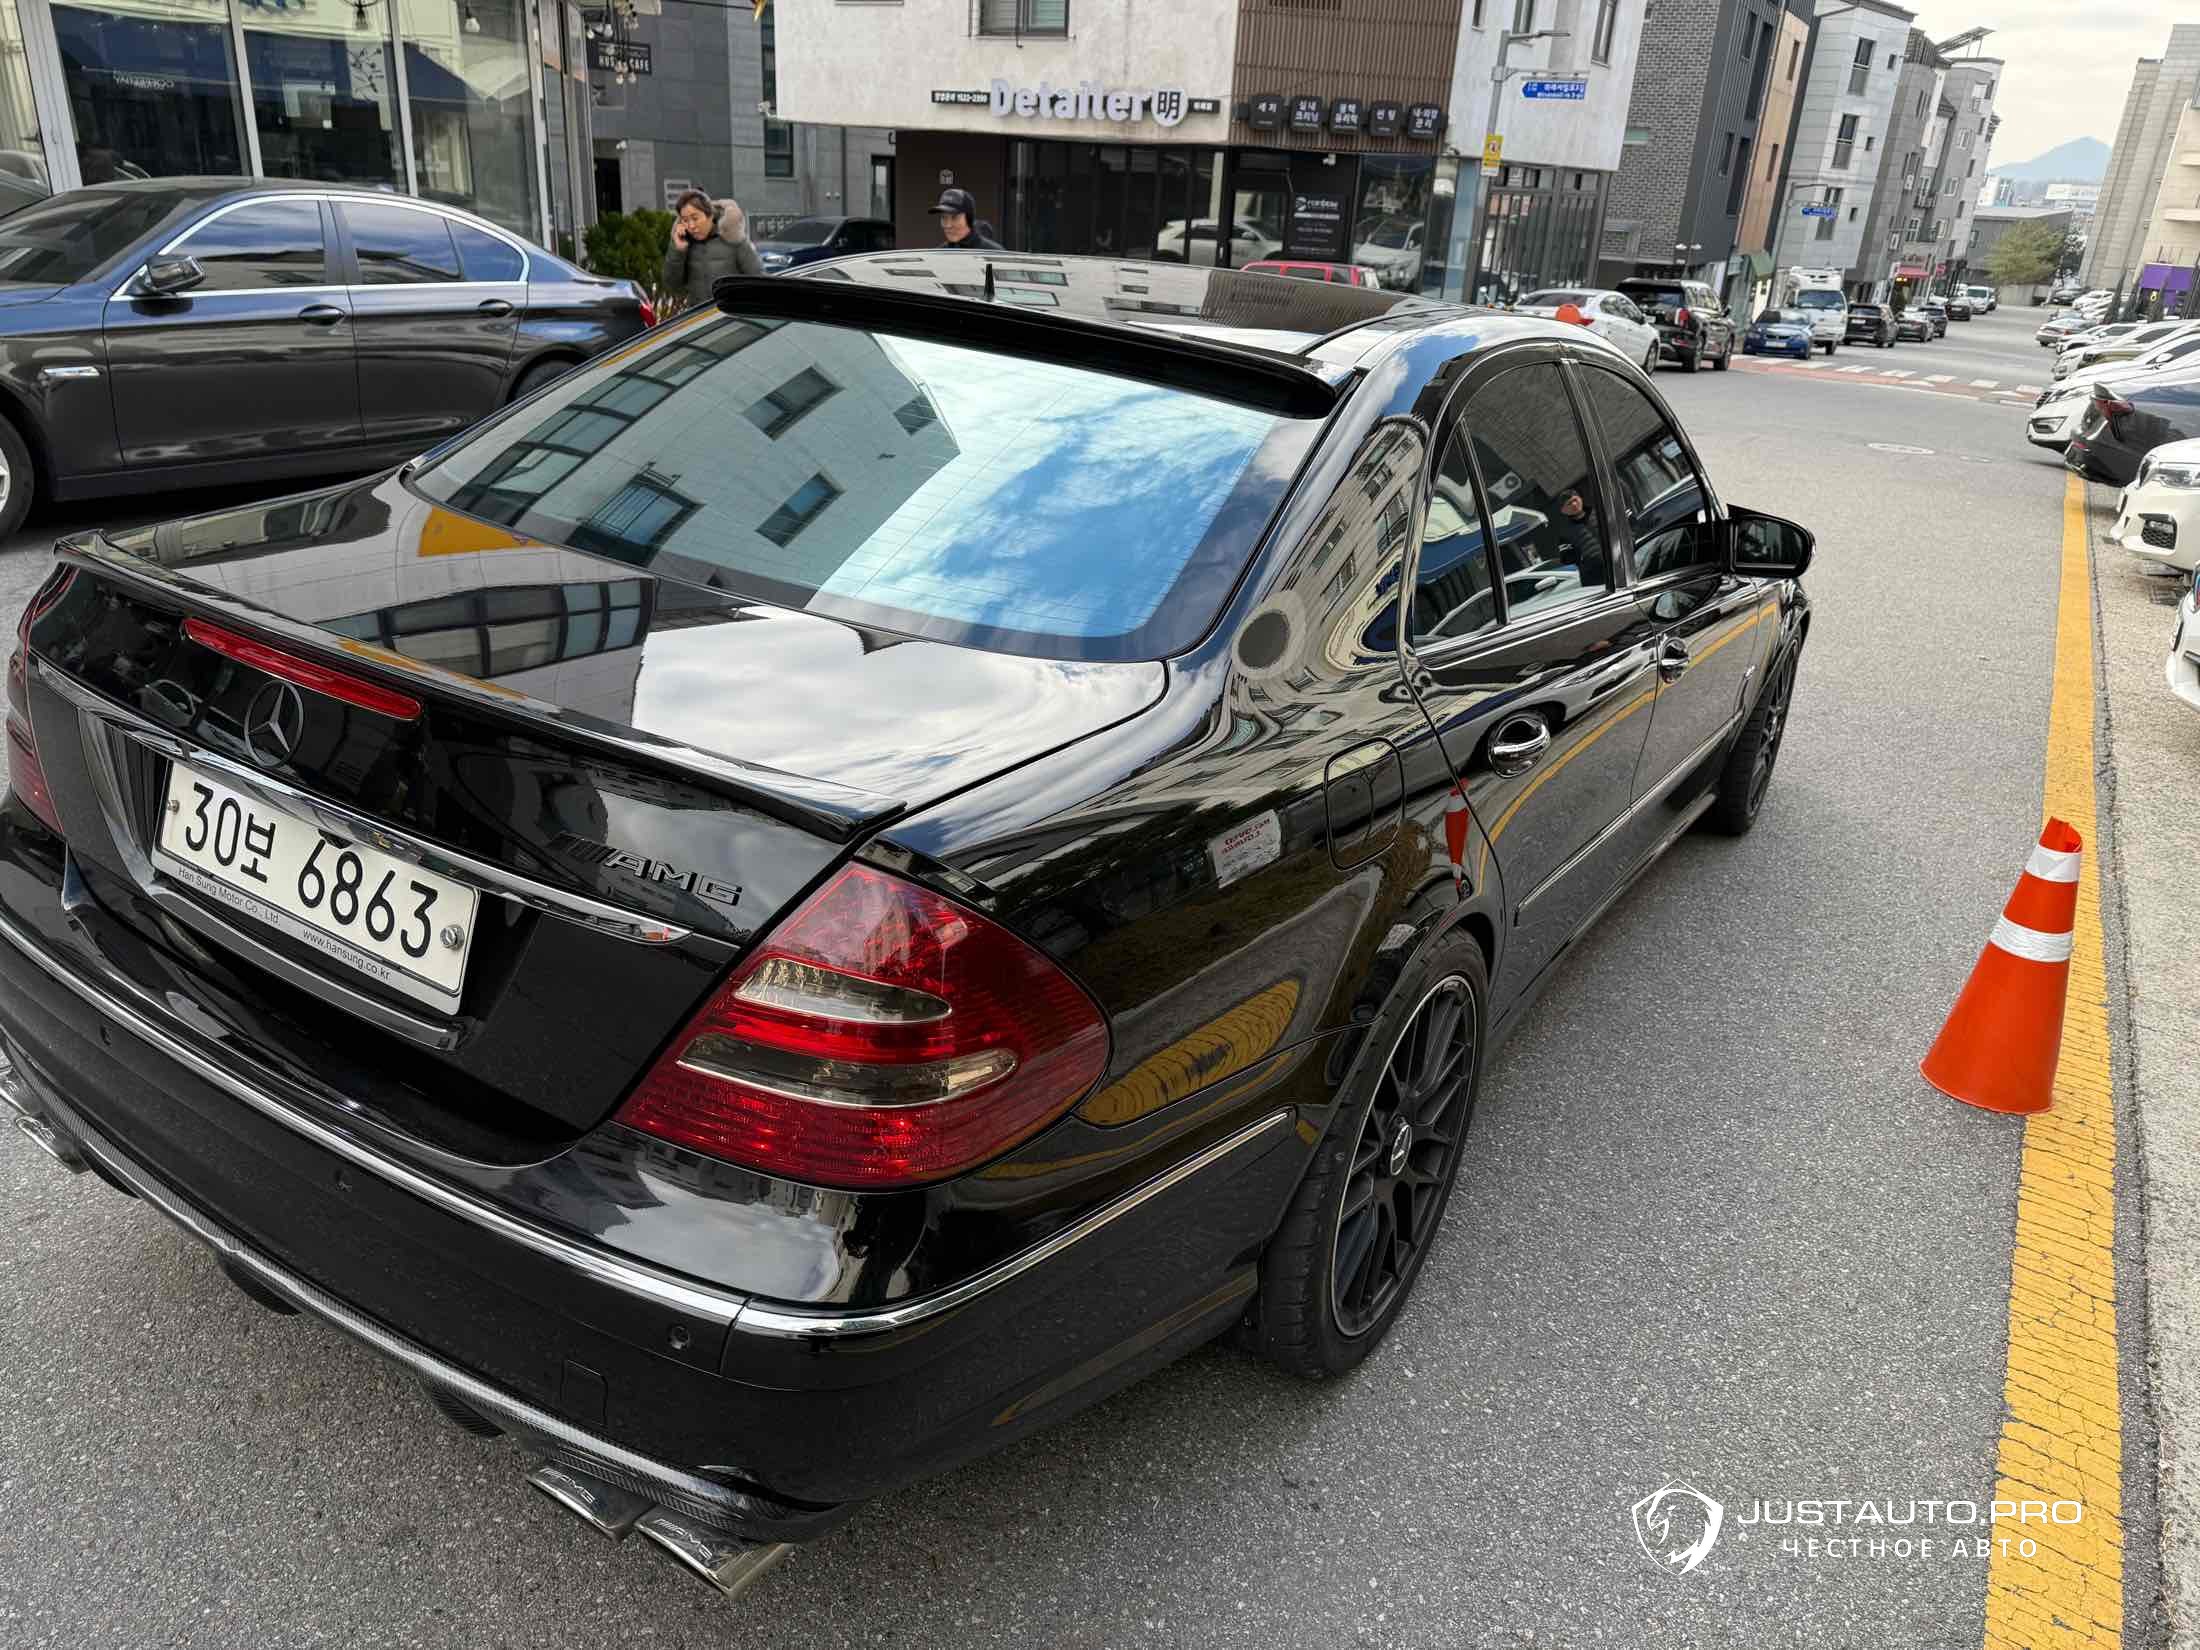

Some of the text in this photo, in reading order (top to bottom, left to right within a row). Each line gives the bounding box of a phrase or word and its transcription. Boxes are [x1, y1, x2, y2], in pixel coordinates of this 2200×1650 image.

[629, 58, 649, 71] CAFE
[991, 78, 1151, 122] Detailer
[185, 781, 438, 958] 30보 6863
[600, 847, 744, 906] AMG
[178, 867, 194, 882] Han
[195, 874, 216, 896] Sung
[217, 884, 244, 906] Motor
[302, 928, 392, 981] www.hansung.co.kr
